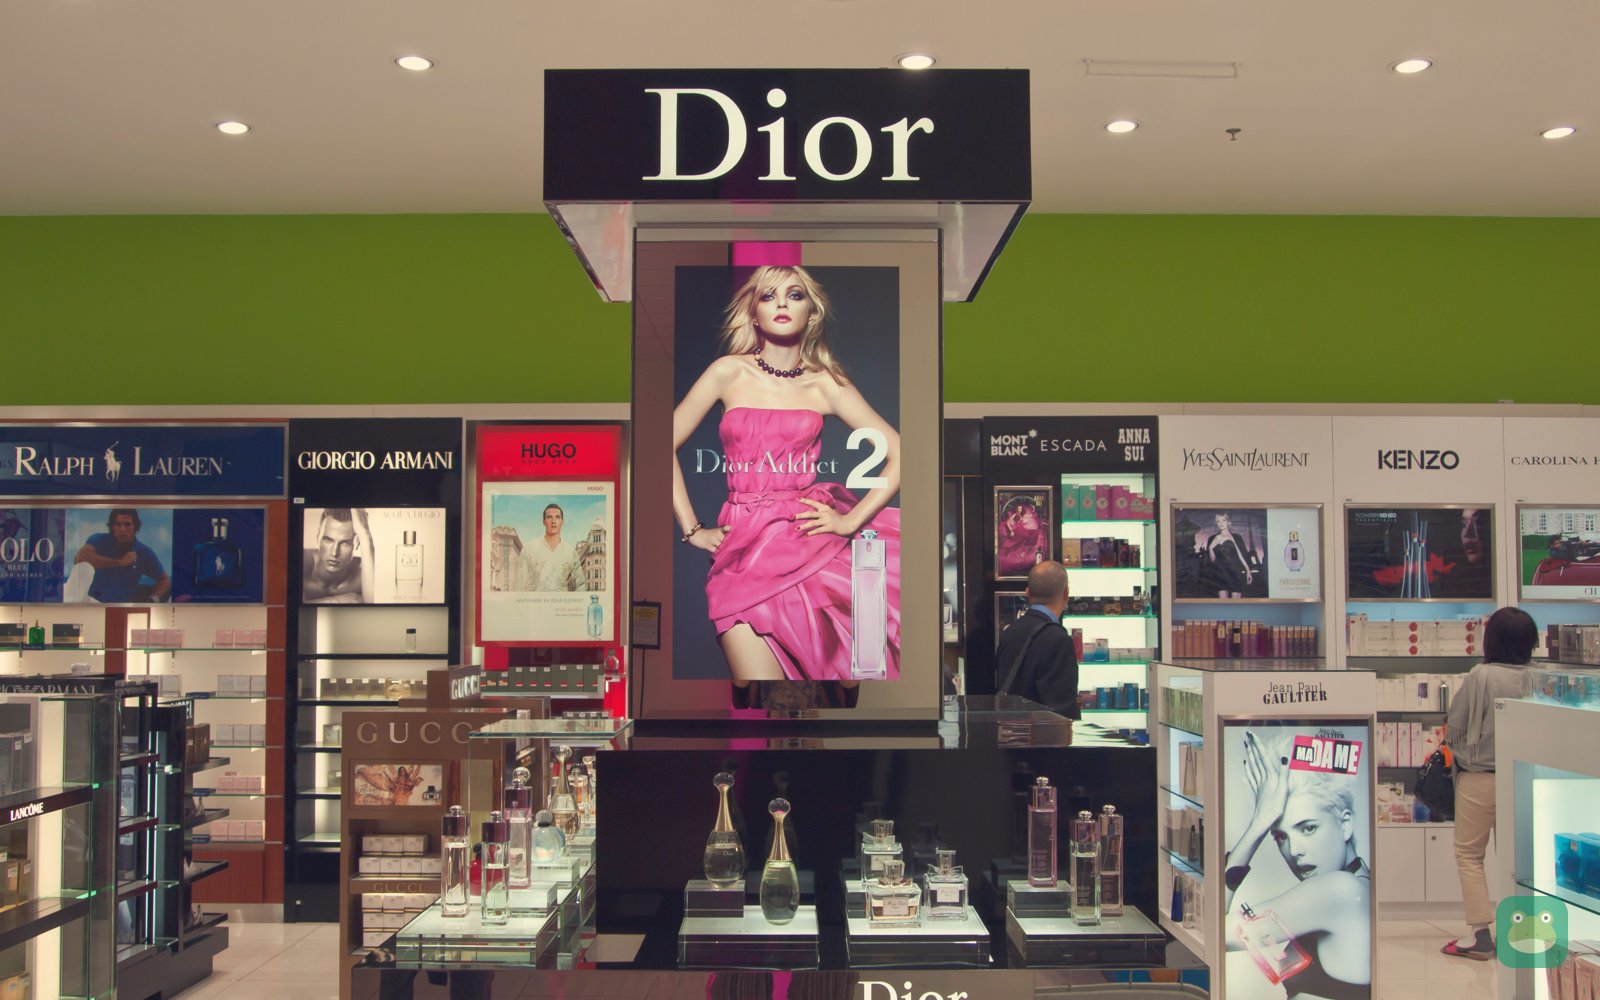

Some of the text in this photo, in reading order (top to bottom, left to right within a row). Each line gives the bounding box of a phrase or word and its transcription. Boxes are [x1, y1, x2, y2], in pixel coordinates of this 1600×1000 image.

[642, 88, 935, 181] Dior
[990, 435, 1028, 446] MONT
[1117, 428, 1151, 444] ANNA
[521, 443, 577, 459] HUGO
[990, 445, 1028, 456] BLANC
[1040, 439, 1107, 452] ESCADA
[14, 446, 223, 476] RALPH LAUREN
[297, 450, 453, 470] GIORGIO ARMANI
[695, 427, 889, 489] Dior Addict 2
[1124, 446, 1145, 462] SUI
[1378, 449, 1460, 470] KENZO
[1510, 455, 1588, 467] CAROLINA
[0, 537, 54, 563] OLO
[40, 685, 96, 695] ARMANI
[451, 674, 480, 700] GUCCI
[1268, 681, 1323, 693] Jean Paul
[1262, 690, 1328, 705] GAULTIER
[10, 802, 44, 821] LANCÔME
[373, 882, 422, 893] GUCCI
